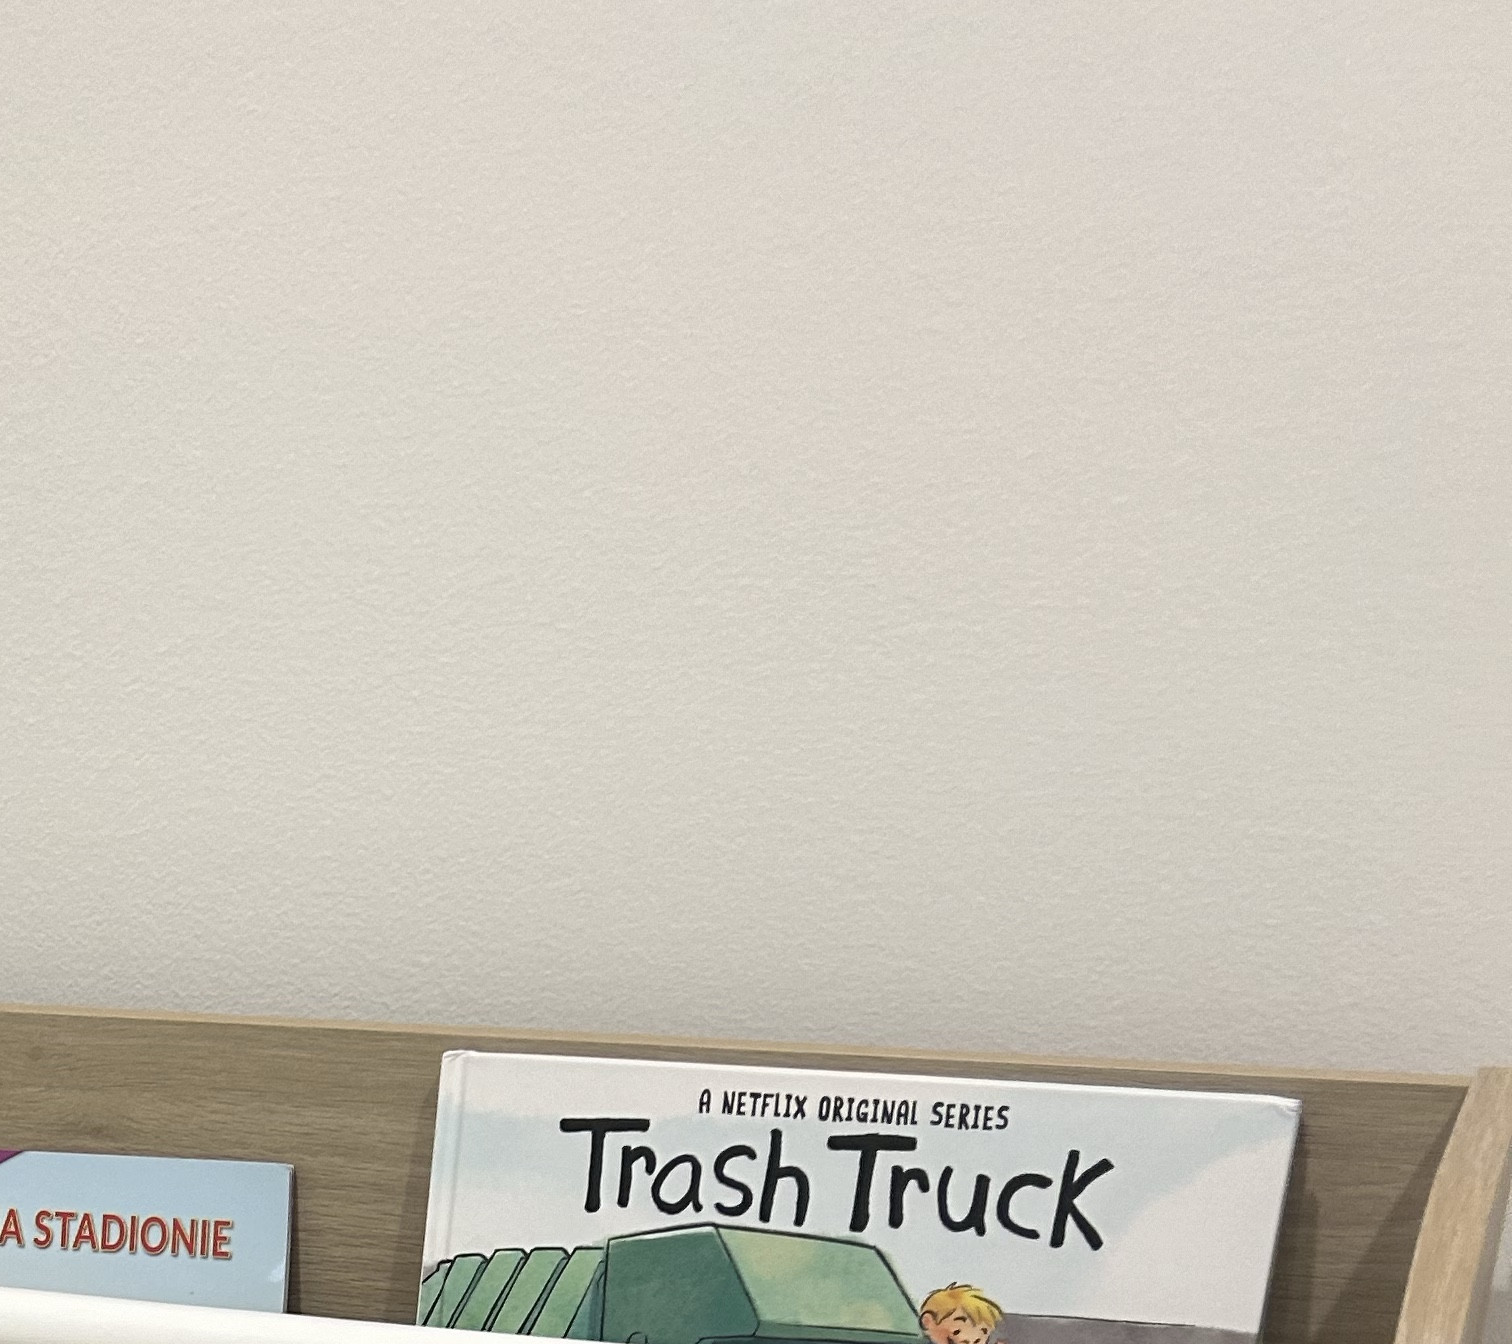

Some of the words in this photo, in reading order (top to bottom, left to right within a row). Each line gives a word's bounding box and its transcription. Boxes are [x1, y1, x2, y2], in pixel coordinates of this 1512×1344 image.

[697, 1088, 713, 1116] A
[721, 1091, 808, 1121] NETFLIX
[818, 1096, 919, 1127] ORIGINAL
[931, 1101, 1010, 1132] SERIES
[559, 1117, 811, 1228] Trash
[33, 1210, 233, 1260] STADIONIE
